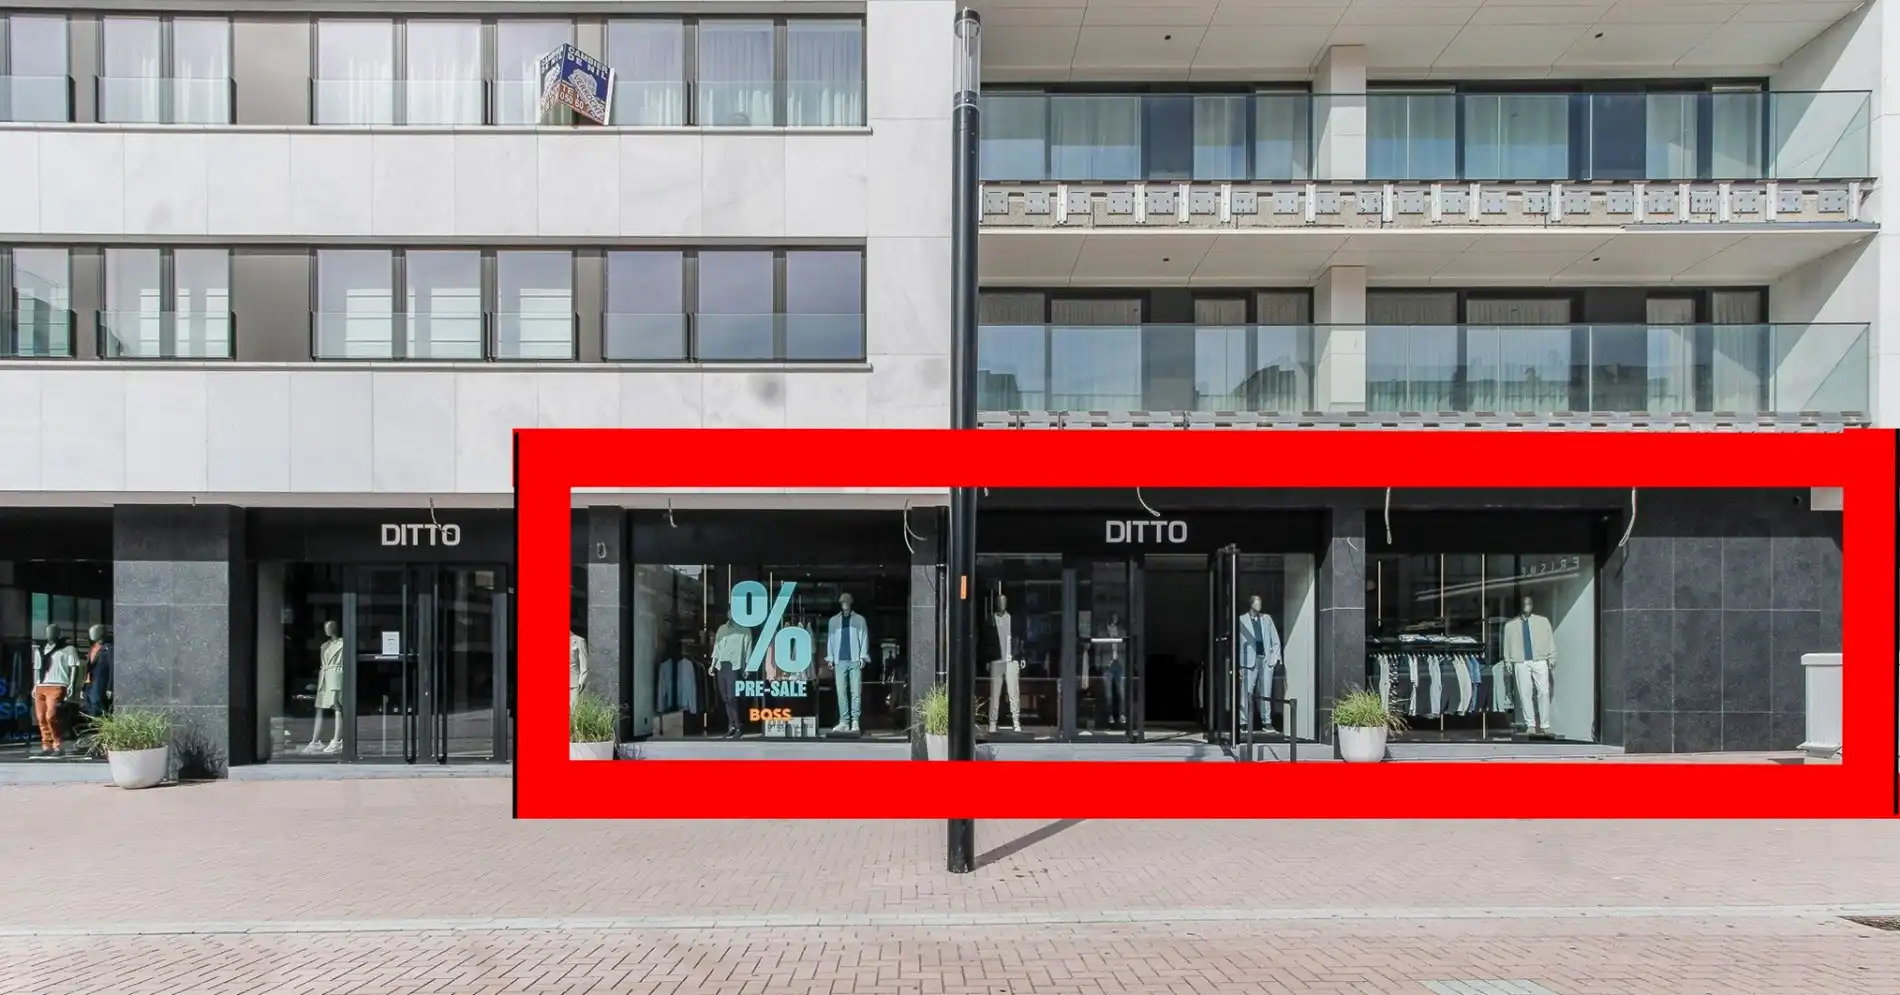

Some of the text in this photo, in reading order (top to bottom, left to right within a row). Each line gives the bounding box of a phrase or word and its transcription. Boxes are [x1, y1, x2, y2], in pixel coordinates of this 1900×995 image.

[567, 52, 582, 66] DE
[587, 64, 607, 80] NIL
[381, 524, 460, 546] DITTO
[1106, 520, 1187, 543] DITTO
[731, 580, 812, 672] %
[735, 680, 807, 697] PRE-SALE
[750, 708, 792, 722] BOSS
